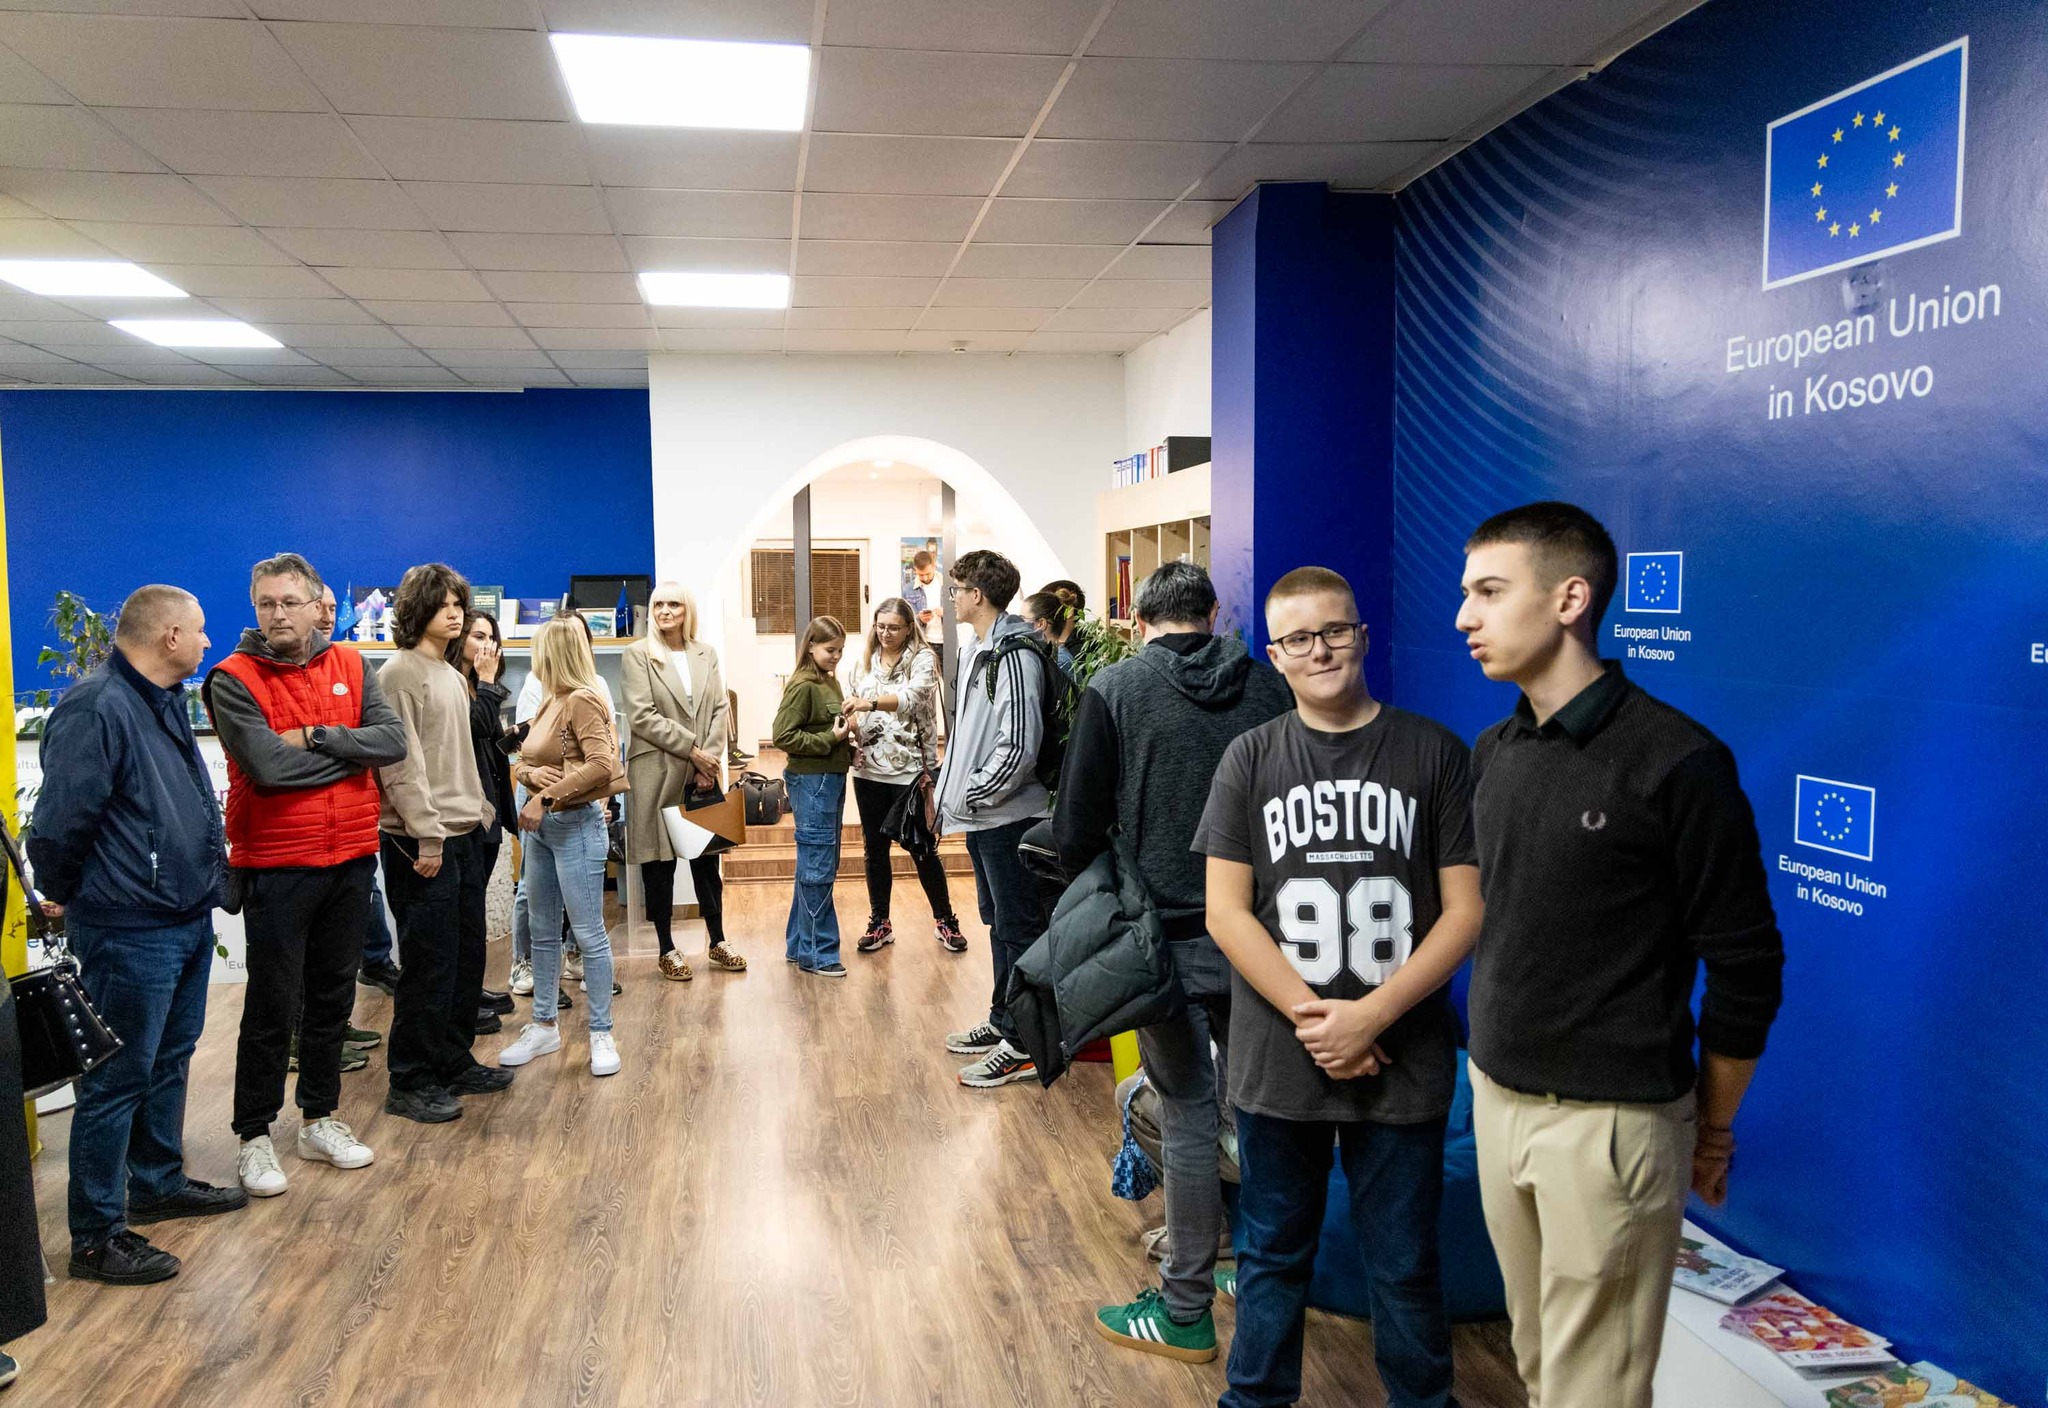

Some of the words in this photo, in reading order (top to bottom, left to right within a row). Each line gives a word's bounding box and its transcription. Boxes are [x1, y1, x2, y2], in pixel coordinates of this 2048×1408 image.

[1726, 313, 1875, 374] European
[1889, 284, 2001, 338] Union
[1768, 385, 1793, 420] in
[1805, 365, 1934, 415] Kosovo
[1614, 624, 1659, 641] European
[1661, 626, 1692, 642] Union
[1627, 644, 1637, 658] in
[1638, 645, 1675, 661] Kosovo
[1262, 779, 1417, 864] BOSTON
[1308, 852, 1373, 862] MASSACHUSETTS
[1778, 854, 1841, 886] European
[1845, 871, 1887, 899] Union
[1797, 882, 1809, 901] in
[1812, 886, 1864, 916] Kosovo
[1276, 876, 1414, 986] 98
